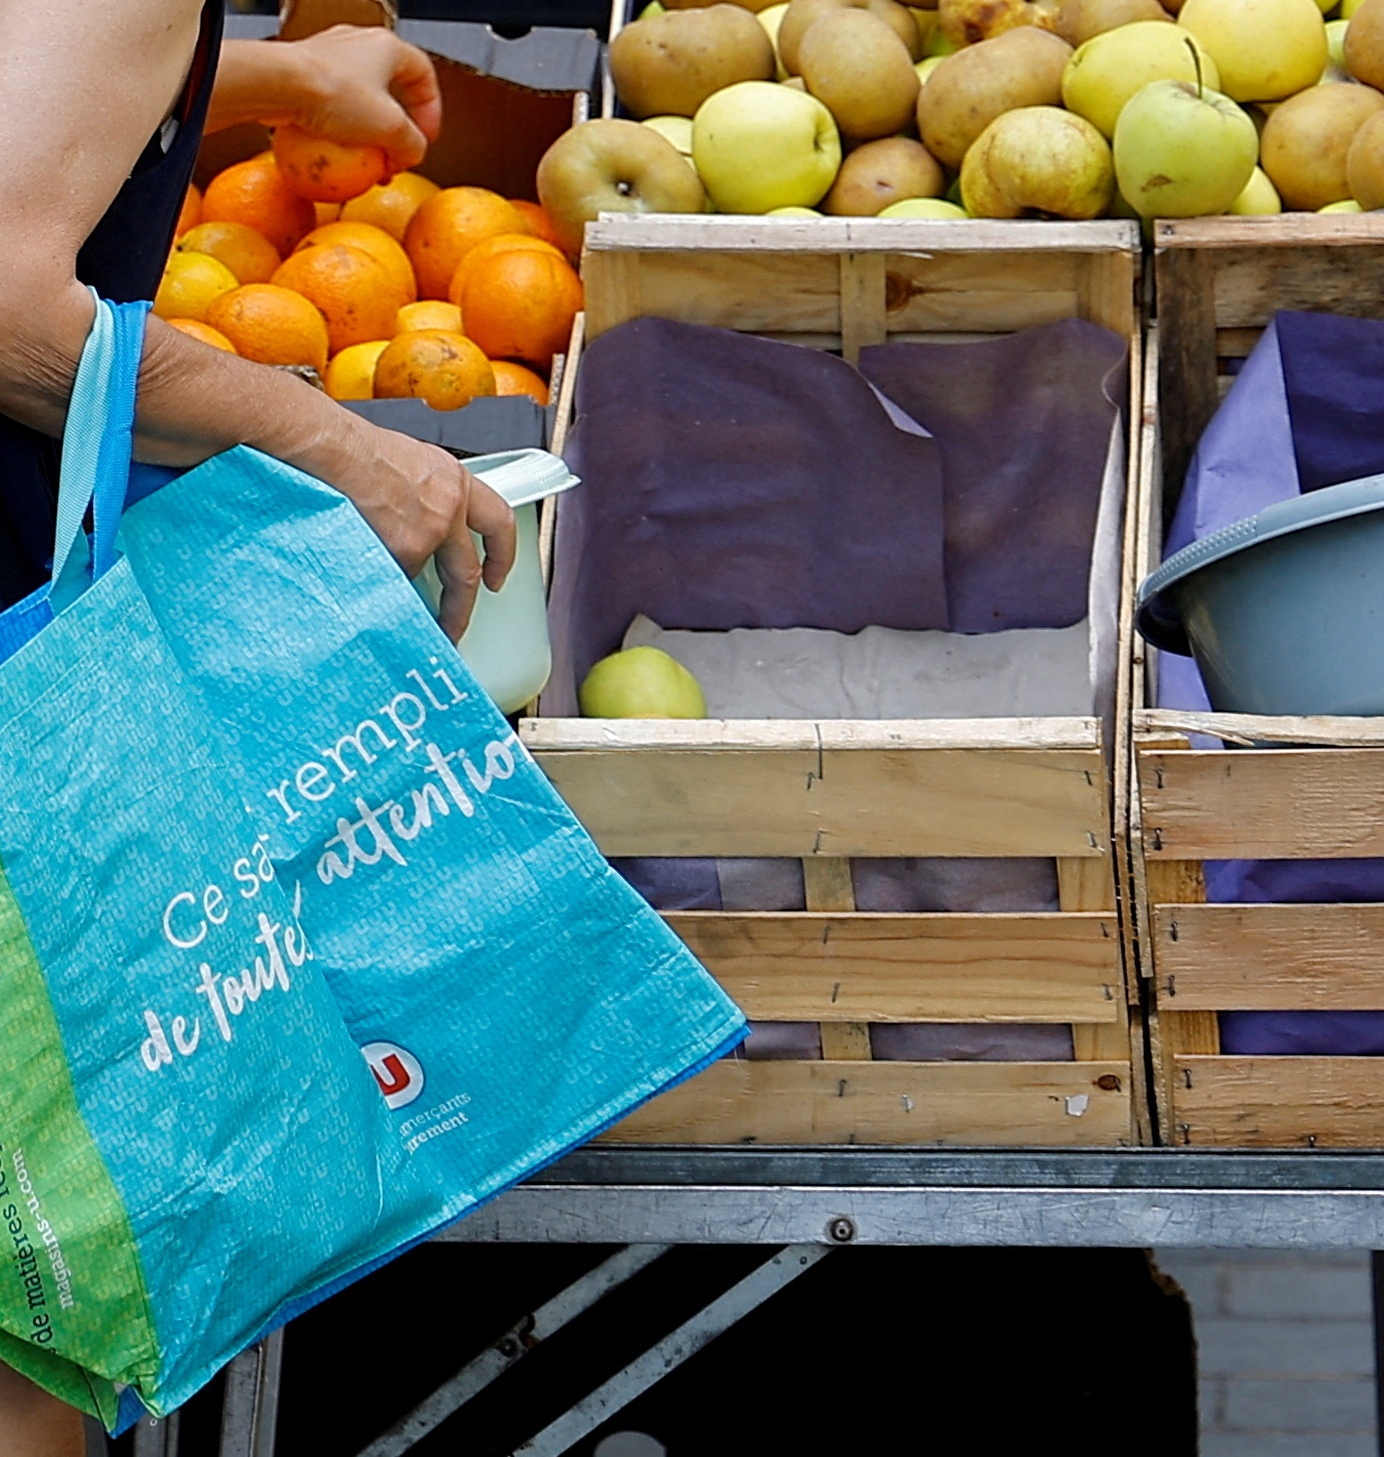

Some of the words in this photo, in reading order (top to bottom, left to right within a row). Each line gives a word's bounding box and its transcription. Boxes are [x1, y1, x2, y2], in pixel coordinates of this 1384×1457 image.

[162, 884, 230, 949] Ce
[266, 655, 470, 825] rempli
[139, 1009, 201, 1072] de
[196, 909, 314, 1043] toute
[2, 1203, 47, 1310] matières
[13, 1147, 75, 1310] magasins-u.com
[30, 1311, 54, 1344] de
